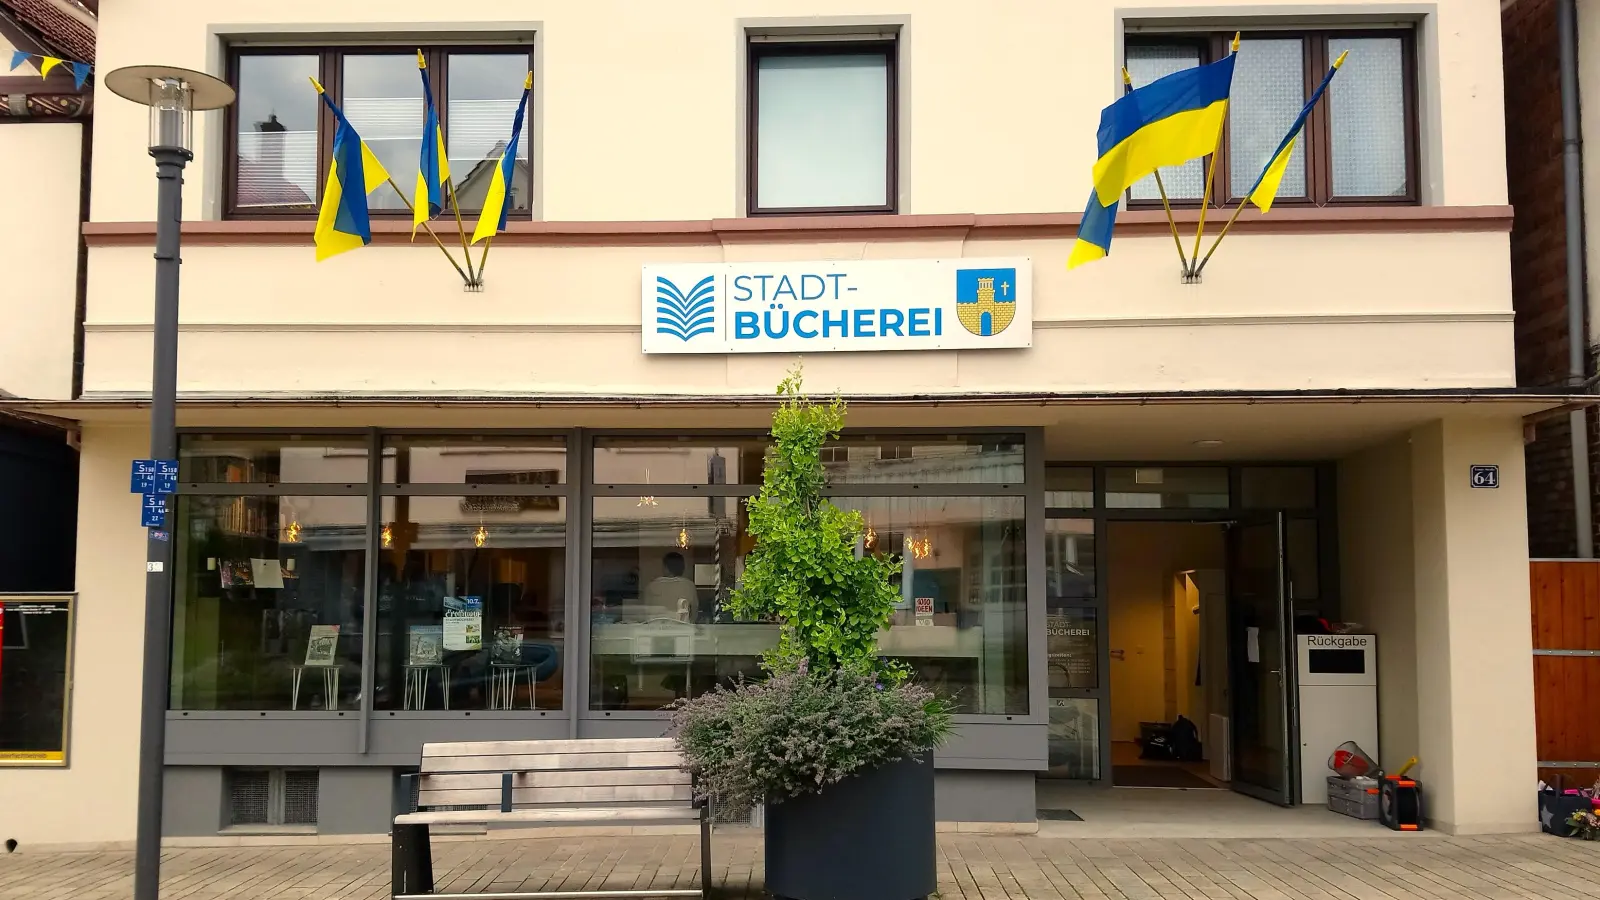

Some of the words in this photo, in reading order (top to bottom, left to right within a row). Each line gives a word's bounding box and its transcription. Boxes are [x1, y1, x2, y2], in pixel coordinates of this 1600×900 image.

[733, 273, 858, 302] STADT-
[734, 303, 942, 339] BÜCHEREI
[1473, 471, 1496, 485] 64
[1046, 628, 1090, 636] BÜCHEREI
[1307, 635, 1367, 648] Rückgabe
